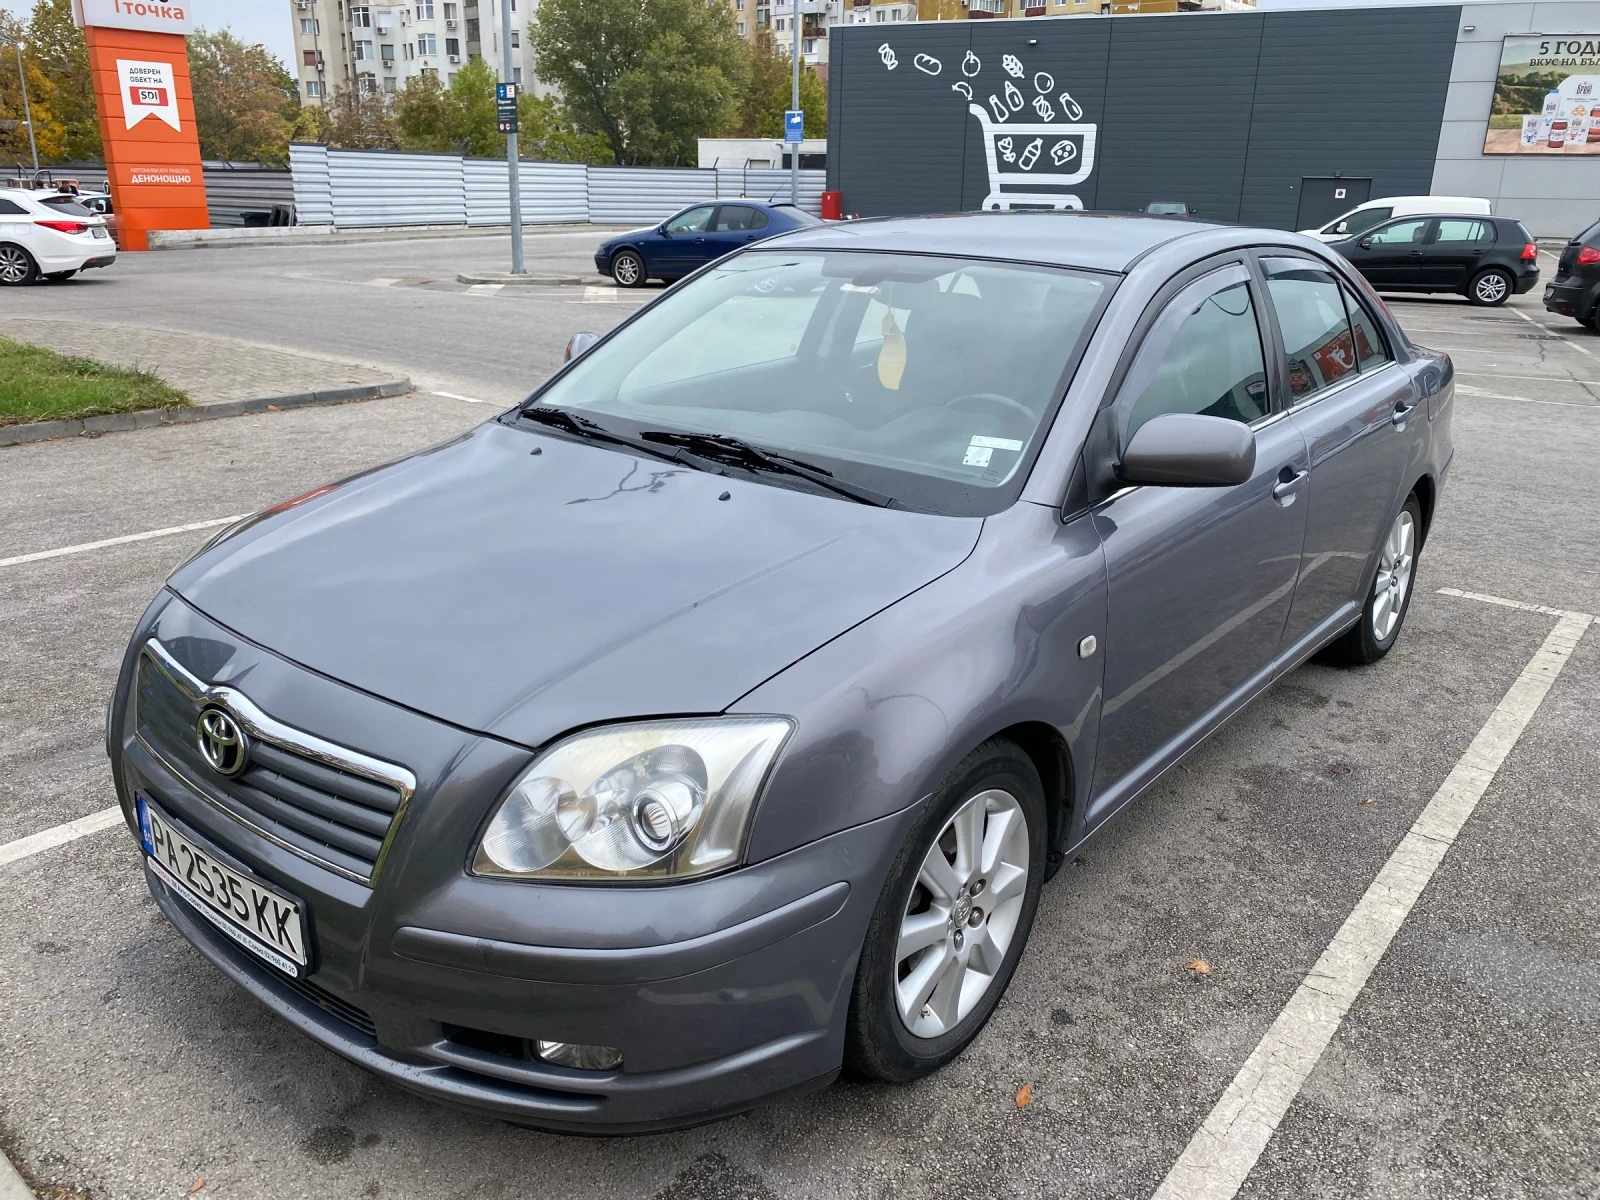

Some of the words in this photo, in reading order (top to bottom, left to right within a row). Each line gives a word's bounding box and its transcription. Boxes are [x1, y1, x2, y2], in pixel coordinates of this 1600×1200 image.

[123, 2, 185, 20] точка
[1539, 41, 1550, 55] 5
[1529, 58, 1558, 66] ВКУС
[1561, 58, 1577, 66] НА
[129, 67, 161, 75] ДОВЕРЕН
[141, 91, 158, 100] SDI
[131, 174, 191, 184] ДЕНОНОЩНО
